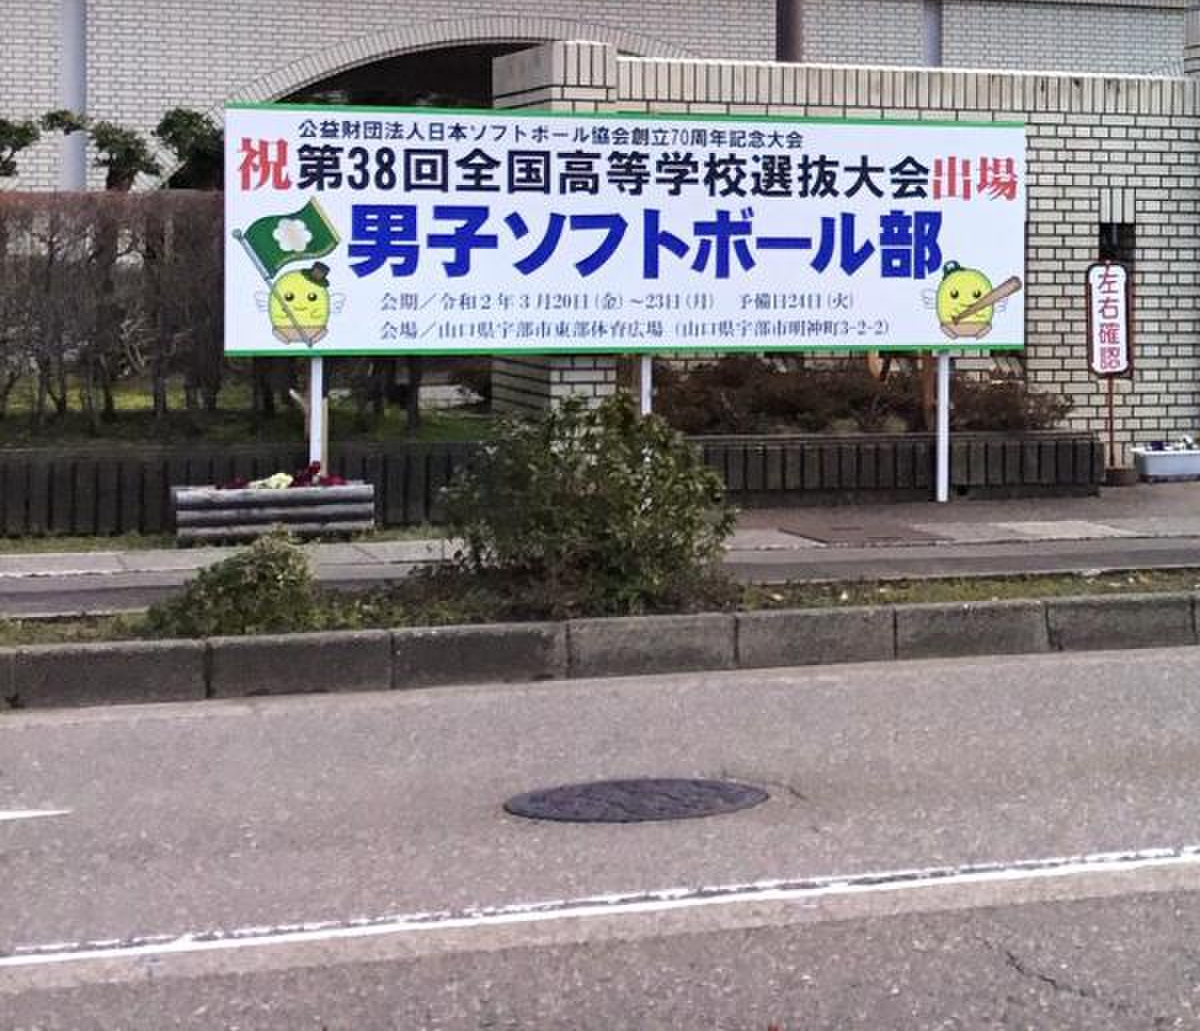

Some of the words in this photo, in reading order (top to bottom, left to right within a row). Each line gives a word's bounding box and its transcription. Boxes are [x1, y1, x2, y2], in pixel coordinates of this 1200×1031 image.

[298, 120, 804, 149] 公益財団法人日本ソフトボール協会創立70周年記念大会
[347, 204, 943, 280] 男子ソフトボール部
[1098, 266, 1121, 370] 左右確認
